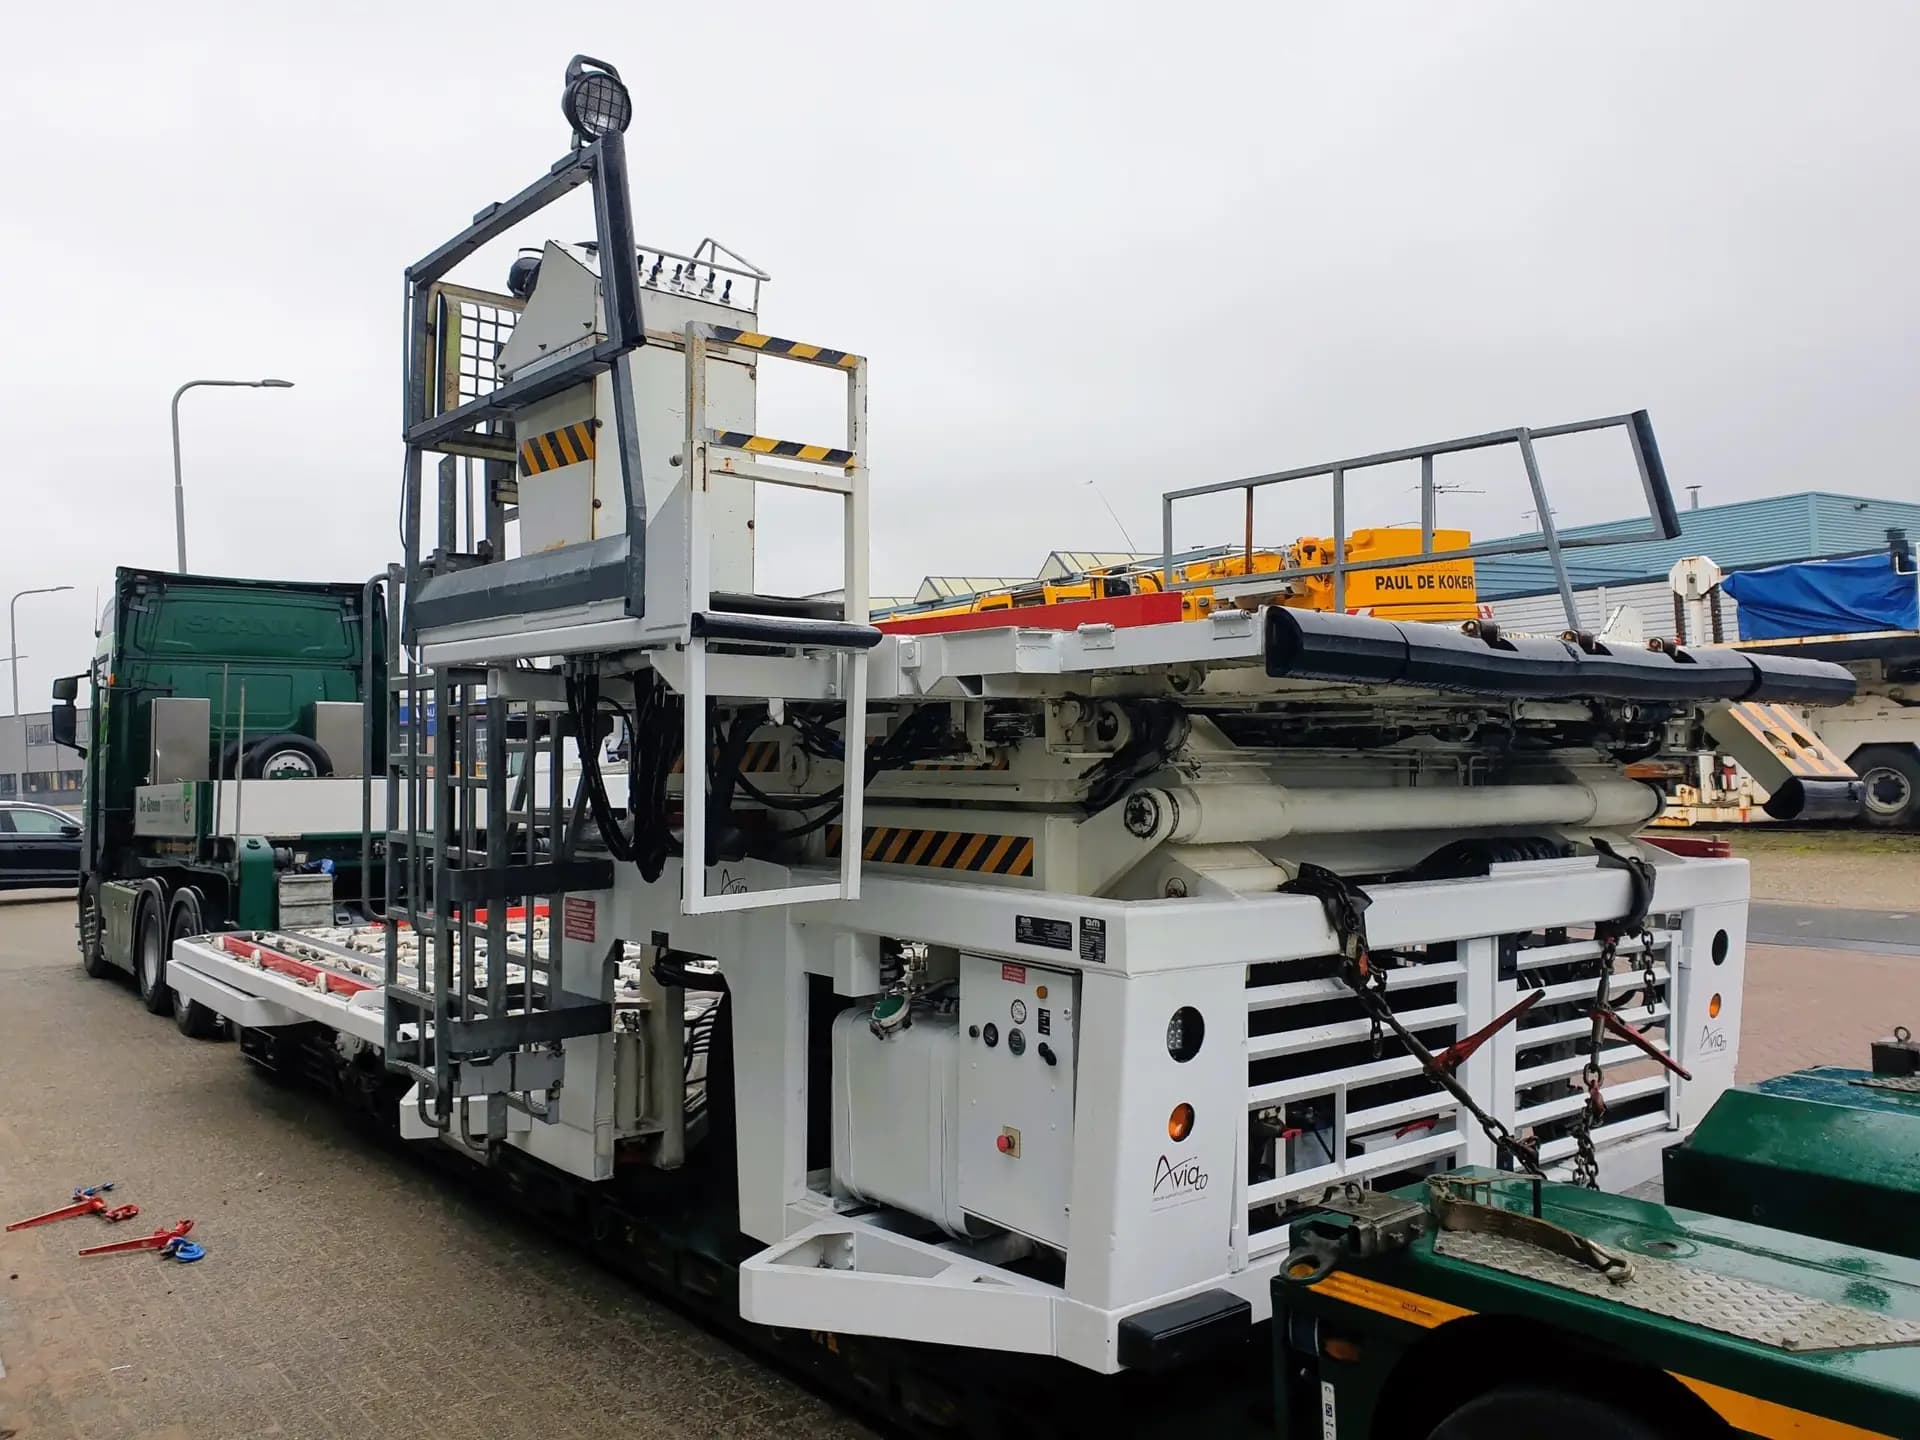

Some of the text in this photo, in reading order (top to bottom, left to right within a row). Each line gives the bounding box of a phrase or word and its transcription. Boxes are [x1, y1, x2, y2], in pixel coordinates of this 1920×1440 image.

[1375, 575, 1474, 590] PAUL DE KOKER
[721, 868, 748, 895] Avia
